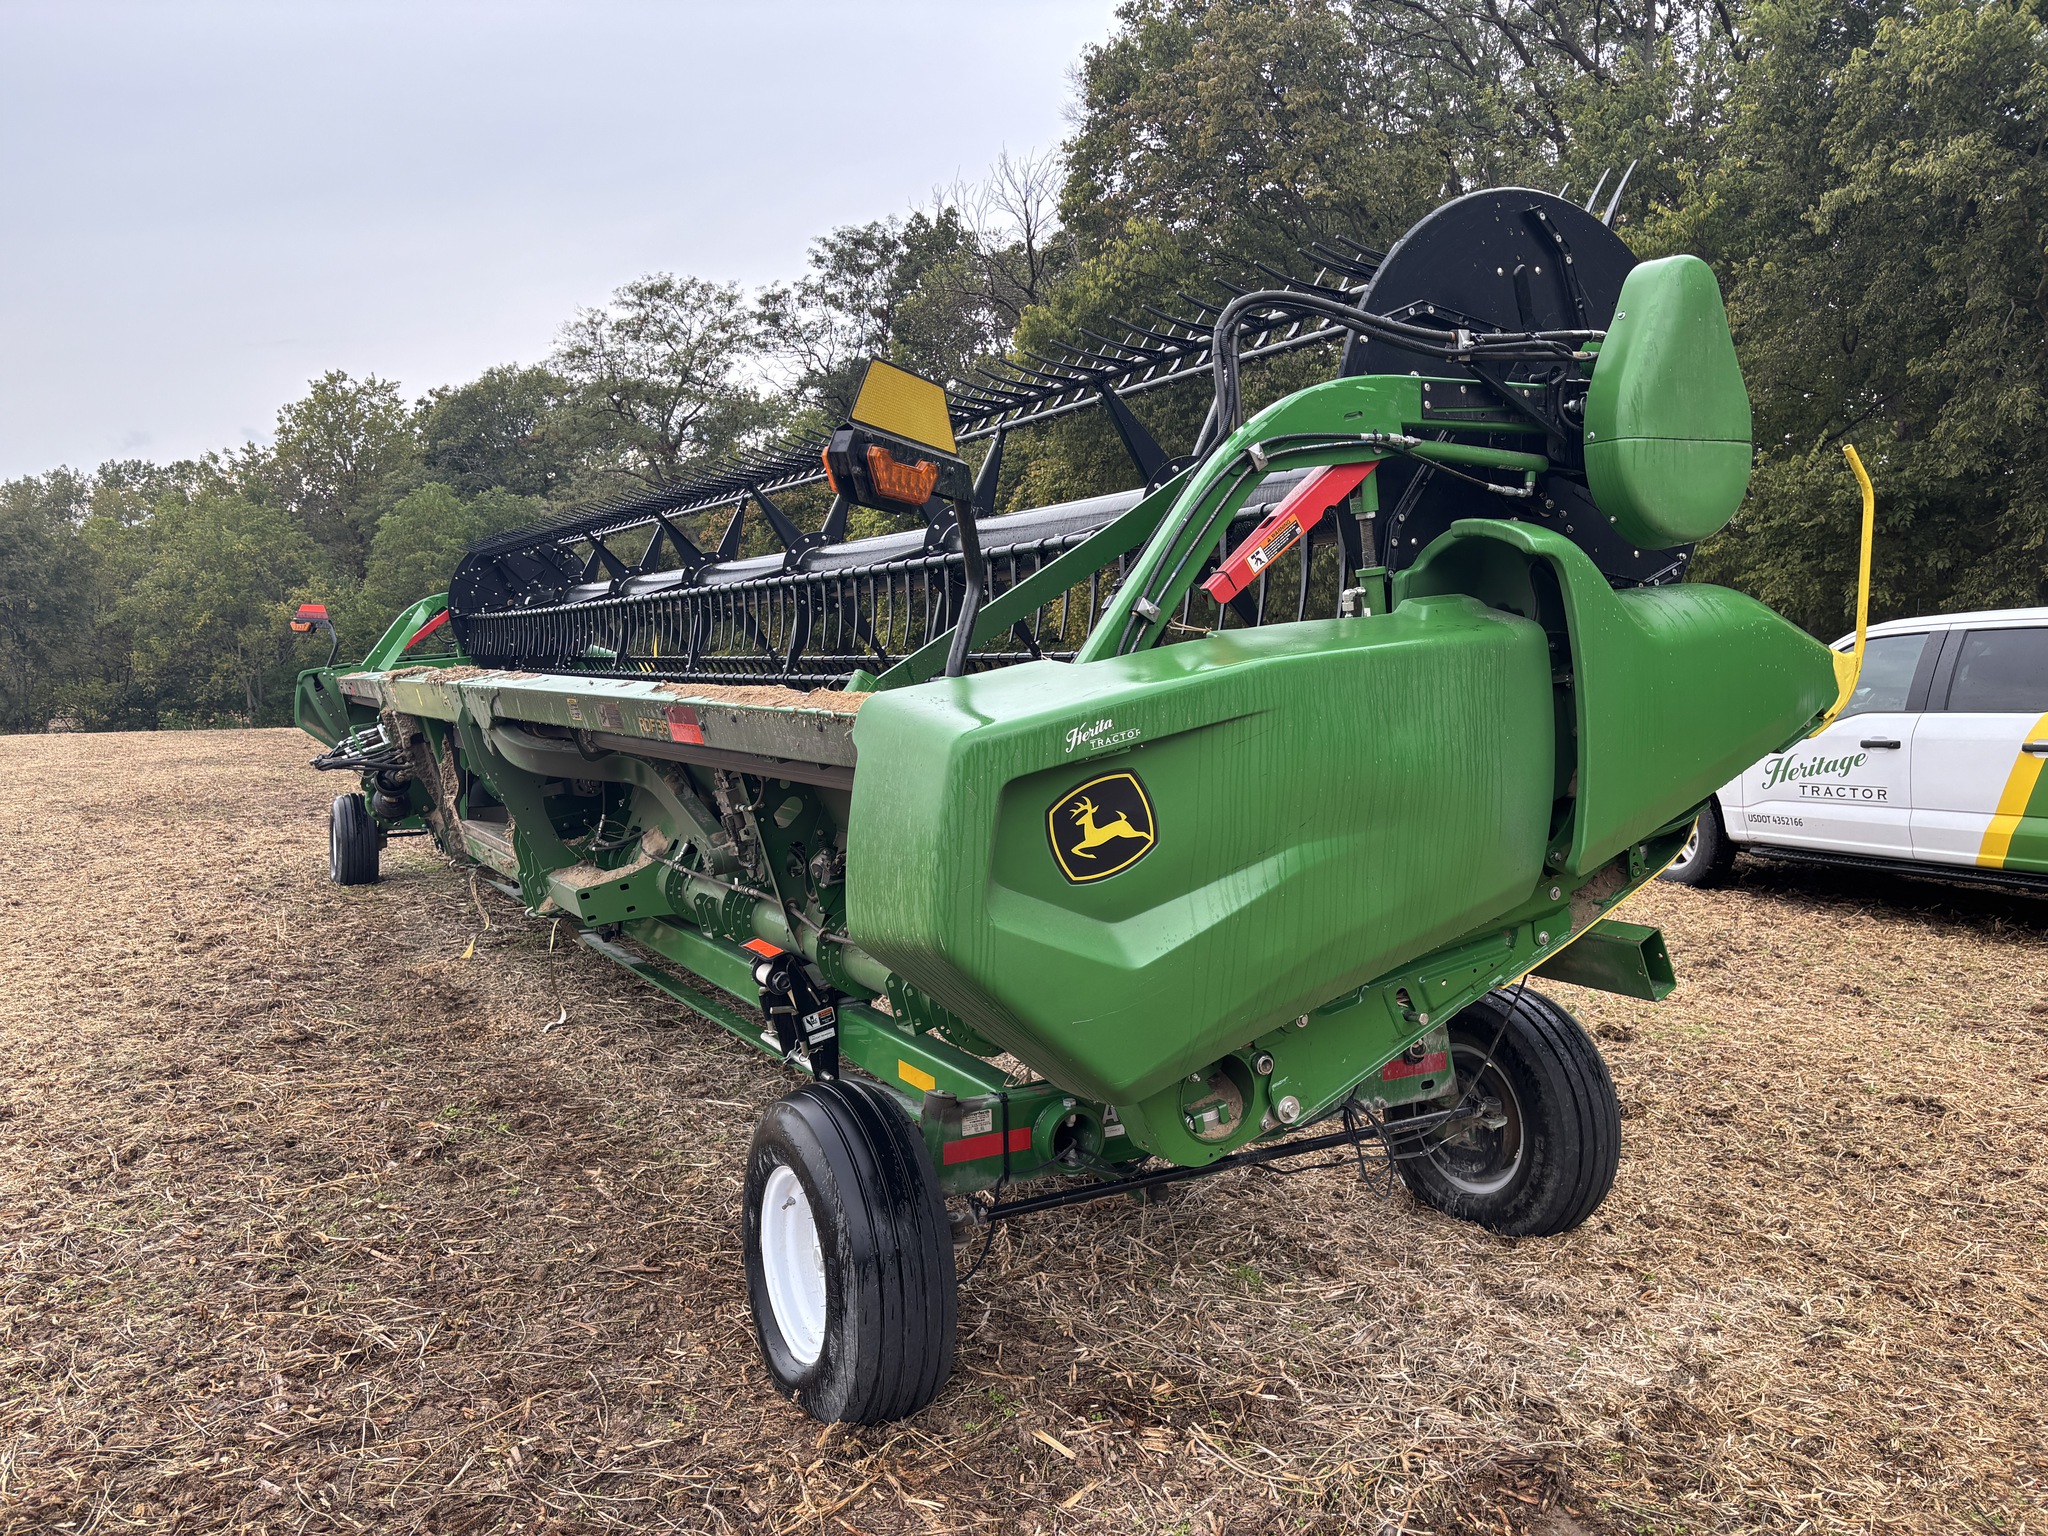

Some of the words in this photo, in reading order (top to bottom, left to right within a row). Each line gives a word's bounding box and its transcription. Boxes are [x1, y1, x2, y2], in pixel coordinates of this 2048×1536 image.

[1761, 752, 1869, 790] Heritage
[1799, 785, 1888, 800] TRACTOR
[1748, 813, 1771, 824] USDOT
[1772, 816, 1804, 827] 4352166
